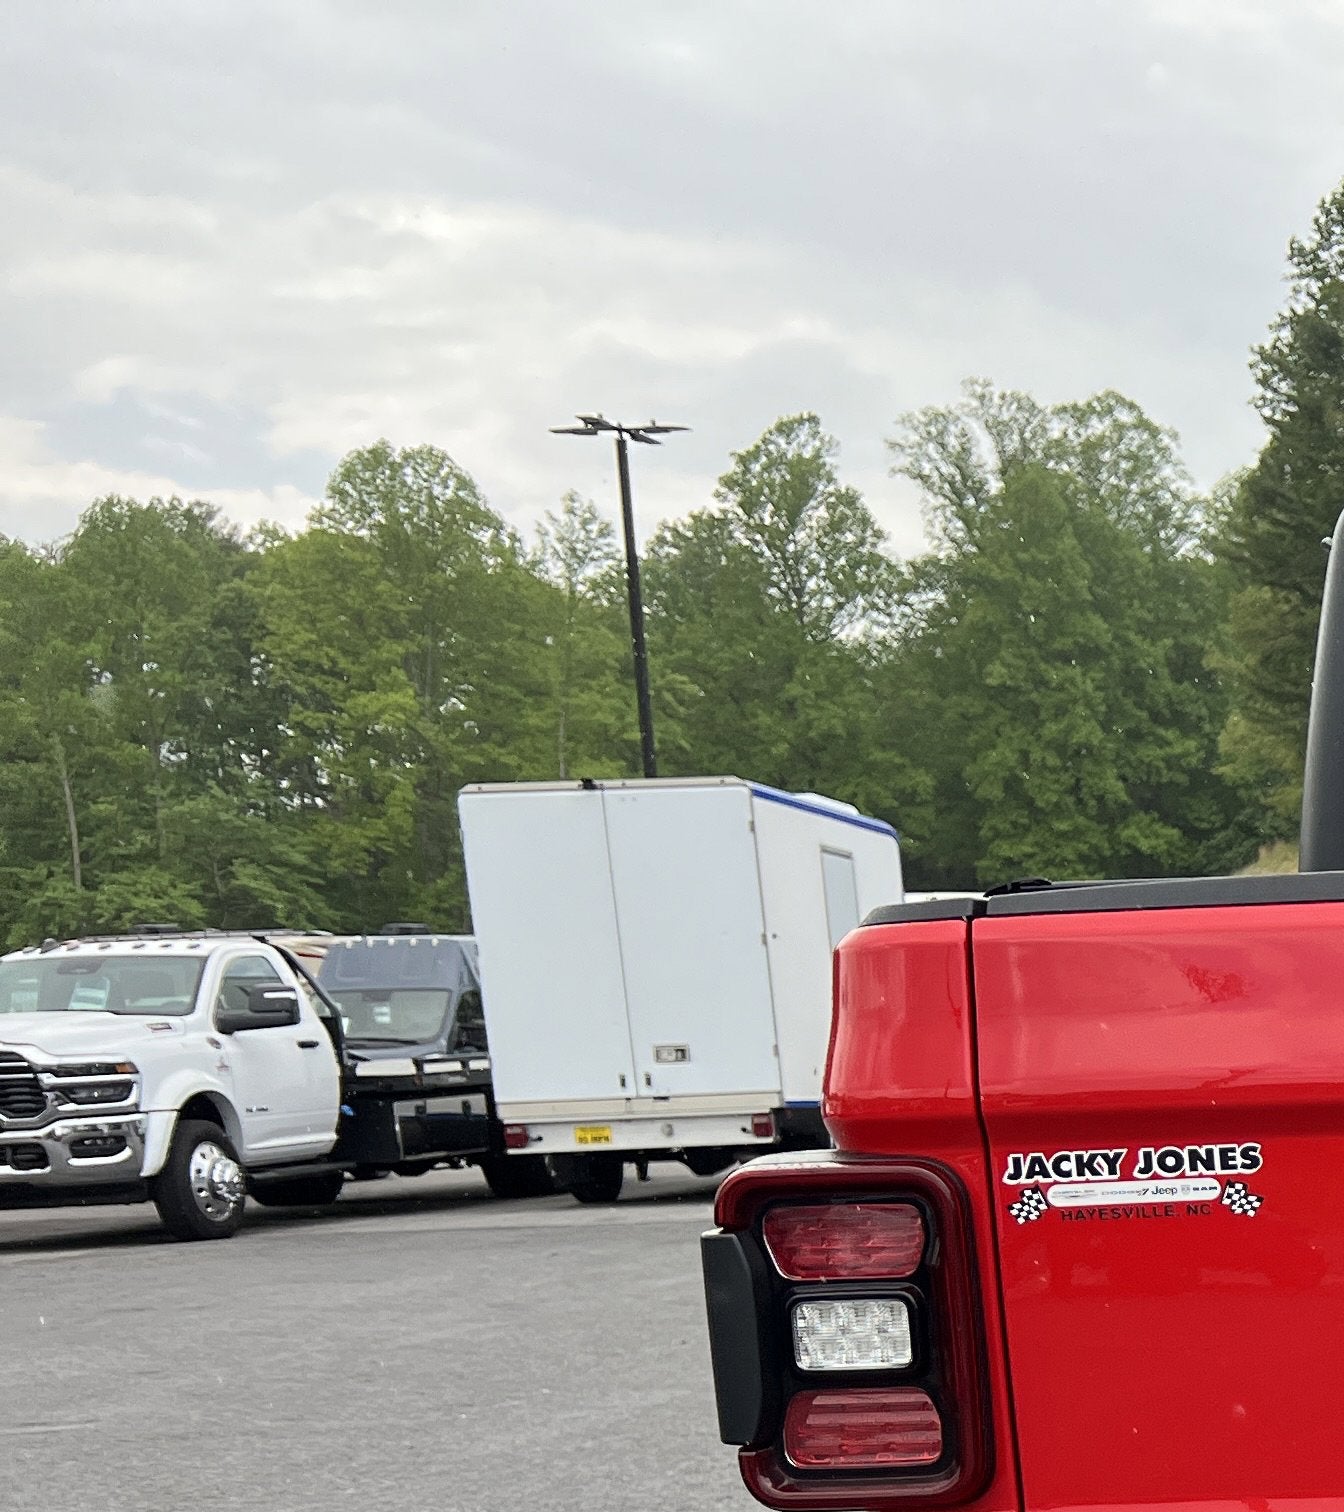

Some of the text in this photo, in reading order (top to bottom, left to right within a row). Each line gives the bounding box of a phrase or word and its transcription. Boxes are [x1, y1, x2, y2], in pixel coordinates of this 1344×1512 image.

[1004, 1143, 1263, 1184] JACKY JONES
[1151, 1185, 1178, 1196] Jeep
[1187, 1204, 1211, 1216] NC
